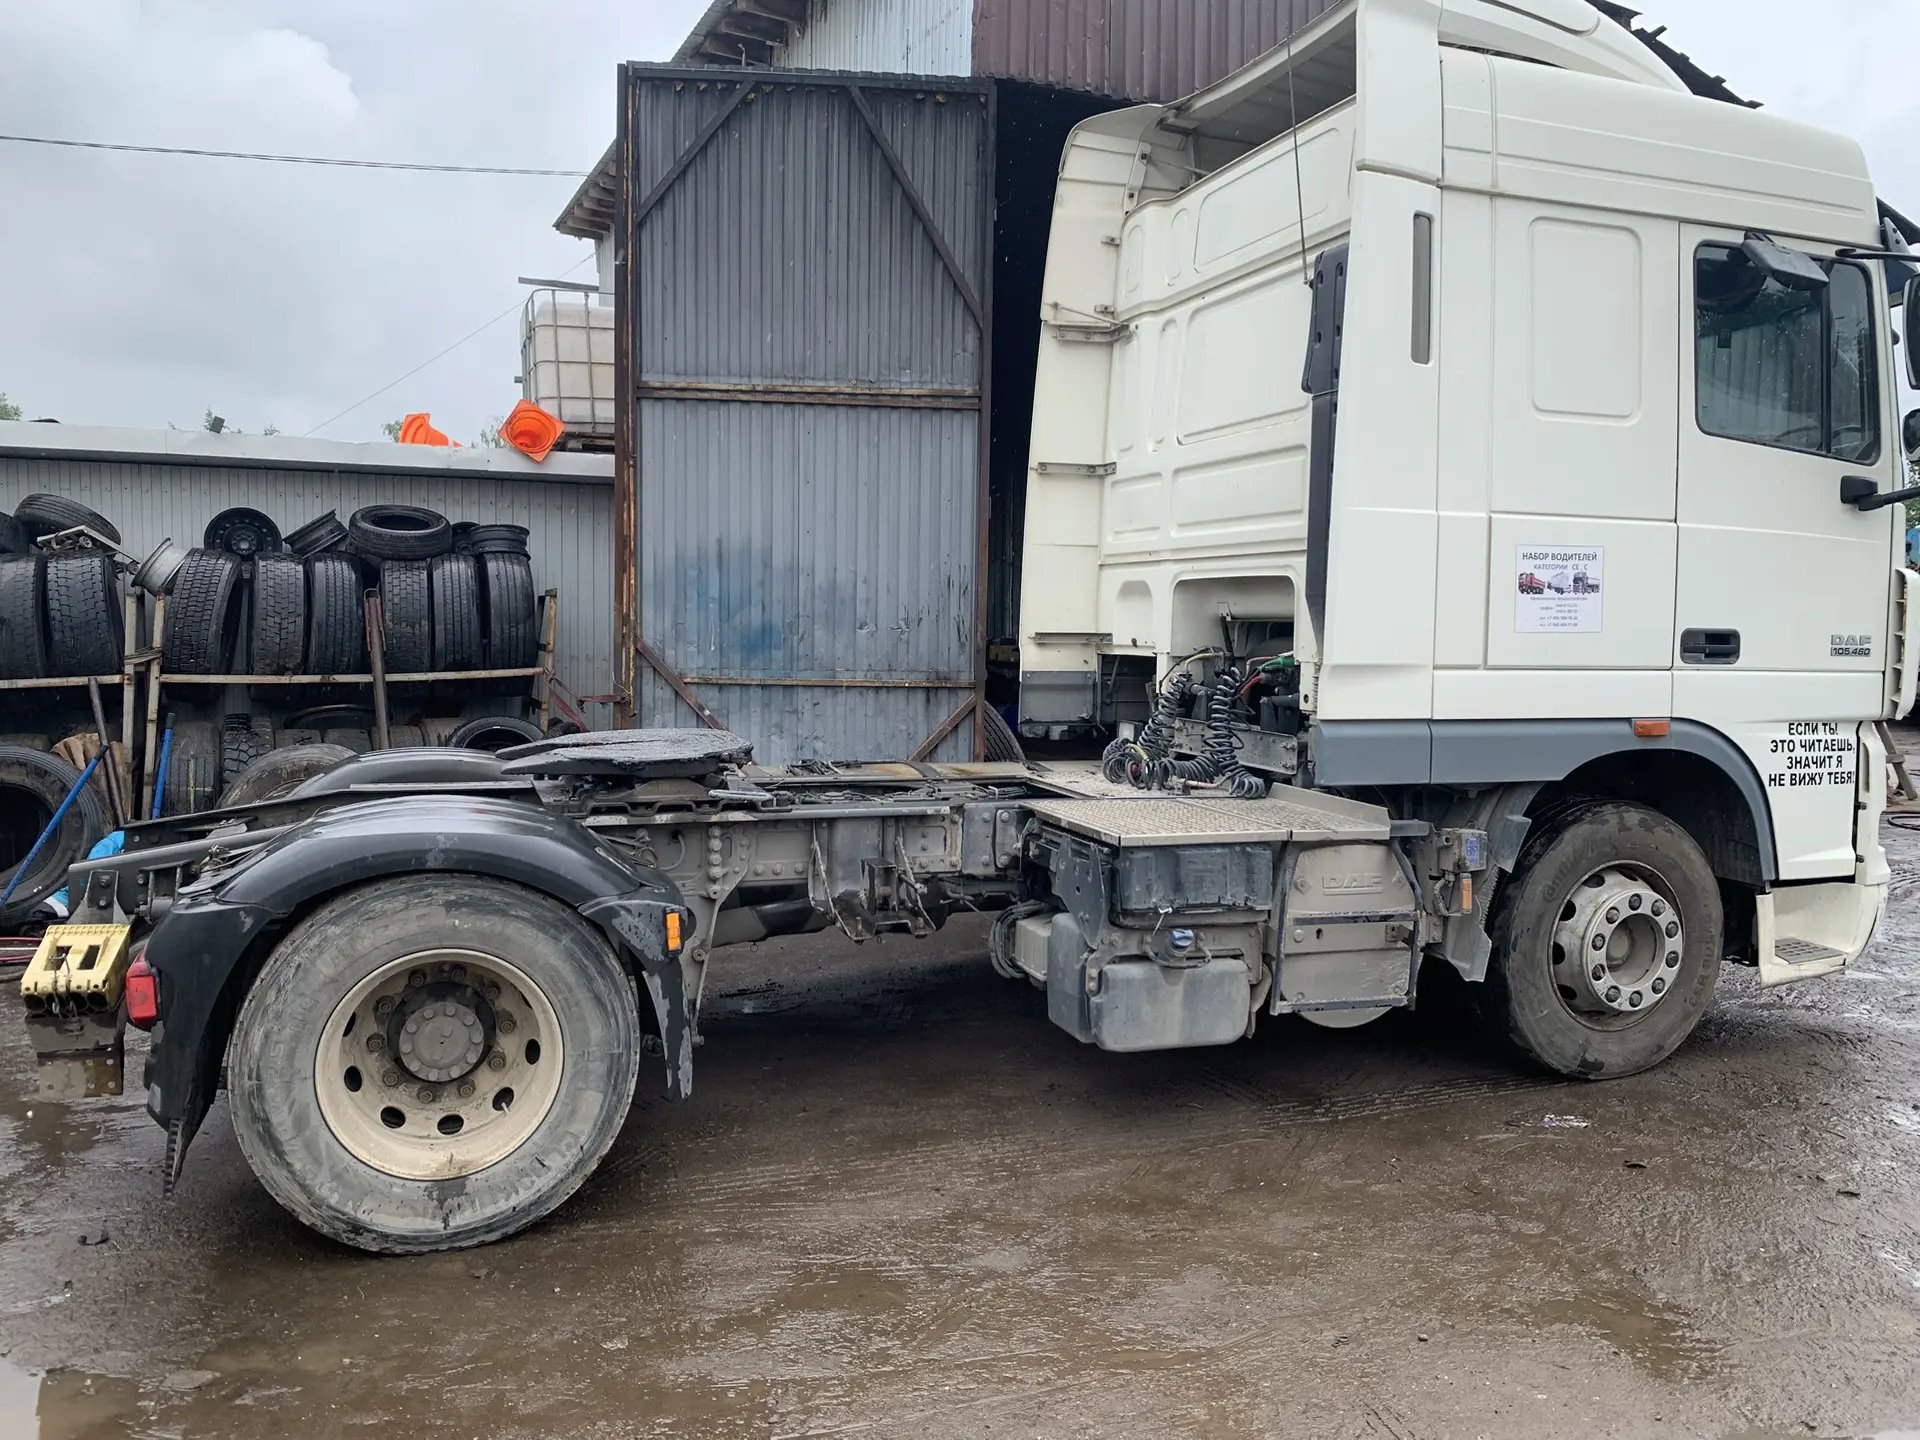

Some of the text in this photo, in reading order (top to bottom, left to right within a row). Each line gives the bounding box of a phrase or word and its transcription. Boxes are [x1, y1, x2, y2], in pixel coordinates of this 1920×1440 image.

[1522, 552, 1598, 562] НАБОР ВОДИТЕЛЕЙ
[1533, 563, 1568, 571] КАТЕГОРИИ
[1831, 634, 1872, 646] DAF
[1770, 738, 1856, 754] ЭТО ЧИТАЕШЬ,
[1786, 755, 1843, 770] ЗНАЧИТ Я
[1768, 771, 1855, 787] НЕ ВИЖУ ТЕБЯ!
[1321, 873, 1384, 890] DAF
